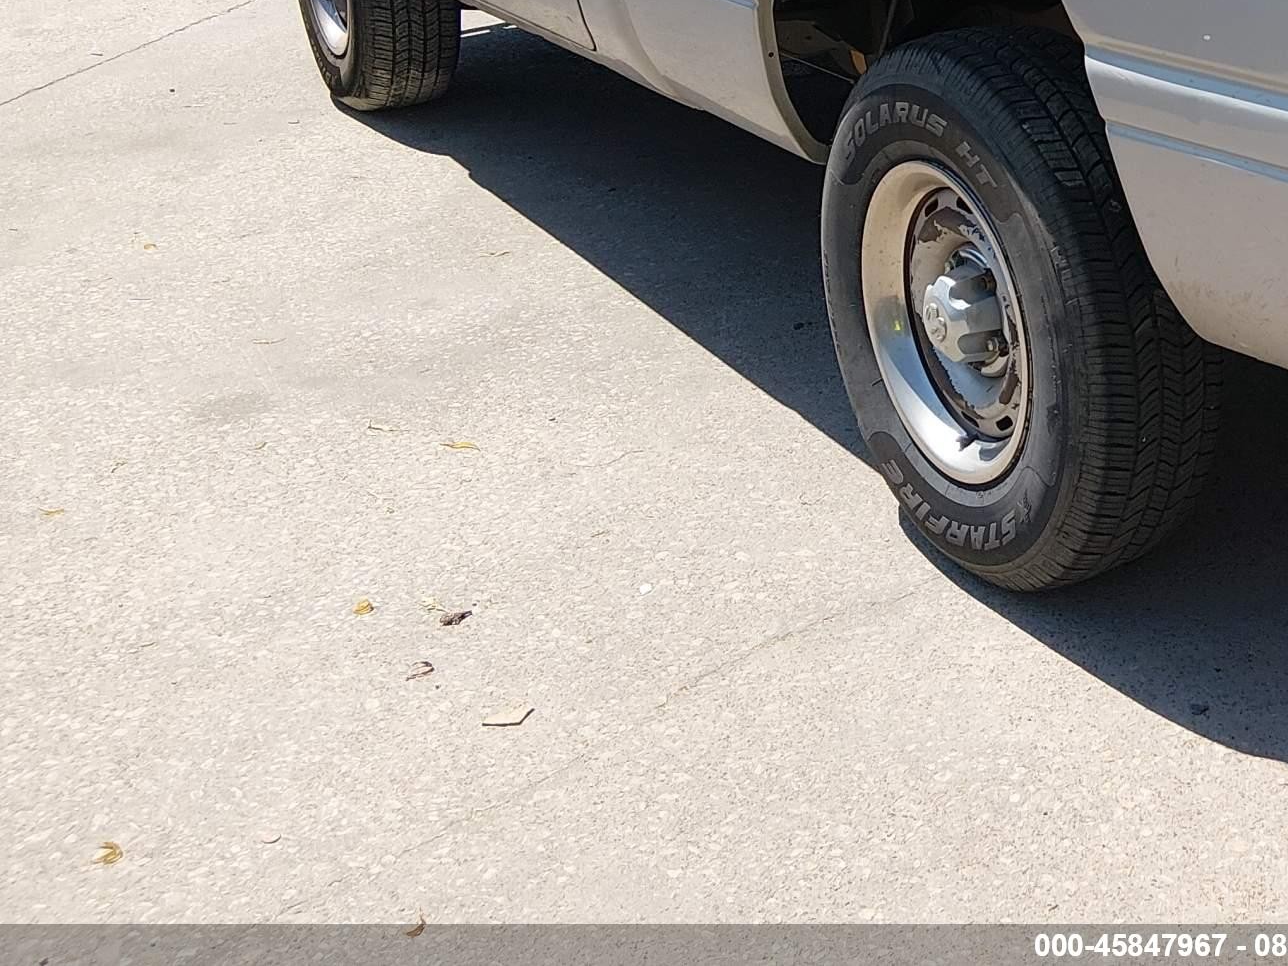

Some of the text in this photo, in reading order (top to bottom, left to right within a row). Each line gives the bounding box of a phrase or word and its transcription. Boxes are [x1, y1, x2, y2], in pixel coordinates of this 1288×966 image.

[845, 101, 998, 188] SOLARUS HT
[877, 459, 1017, 551] STARFIRE
